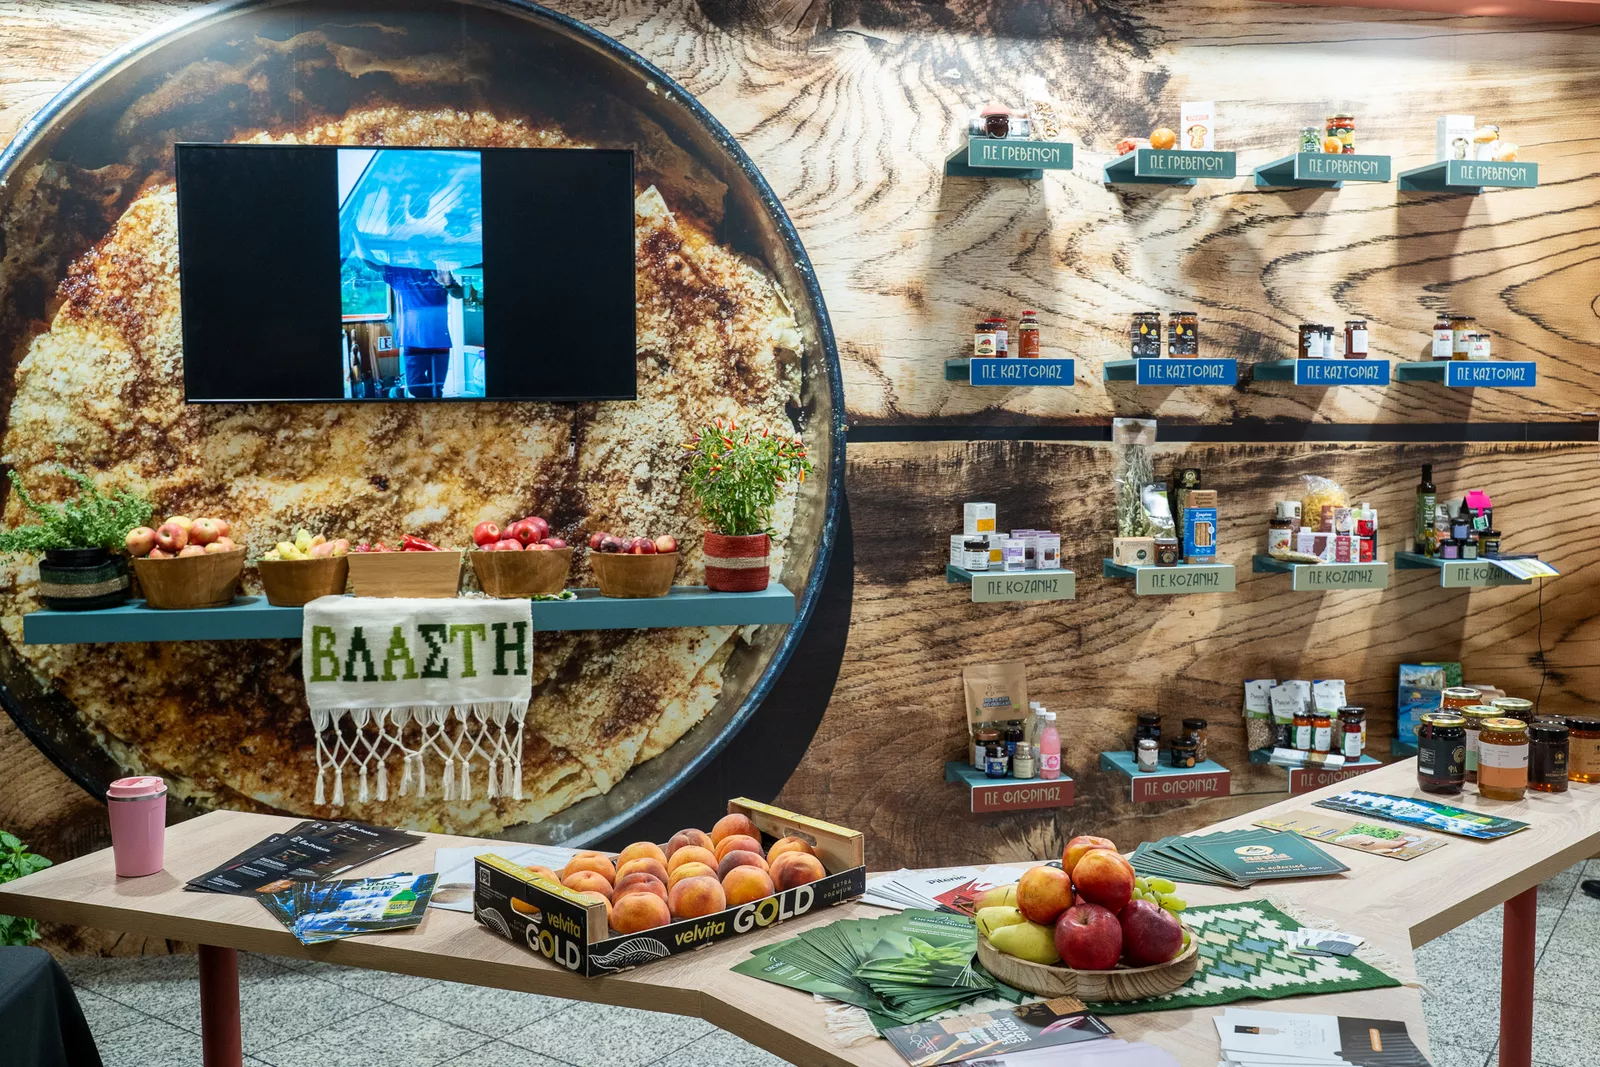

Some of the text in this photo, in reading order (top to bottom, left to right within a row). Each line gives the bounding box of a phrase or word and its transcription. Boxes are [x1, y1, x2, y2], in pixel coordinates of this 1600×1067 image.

[983, 145, 1060, 162] Π.Ε. ΓΡΕΒΕΝΩΝ
[1150, 154, 1223, 171] Π.Ε. ΓΡΕΒΕΝΩΝ
[1309, 158, 1378, 174] Π.Ε. ΓΡΕΒΕΝΩΝ
[1460, 165, 1526, 181] Π.Ε. ΓΡΕΒΕΝΩΝ
[982, 364, 1062, 379] Π.Ε. ΚΑΣΤΟΡΙΑΣ
[1148, 364, 1225, 379] Π.Ε. ΚΑΣΤΟΡΙΑΣ
[1307, 365, 1379, 380] Π.Ε. ΚΑΣΤΟΡΙΑΣ
[1457, 367, 1526, 381] Π.Ε. ΚΑΣΤΟΡΙΑΣ
[1152, 572, 1220, 588] Π.Ε. ΚΟΖΑΝΗΣ
[1309, 569, 1373, 585] Π.Ε. ΚΟΖΑΝΗΣ
[1458, 568, 1472, 581] Π.Ε.
[988, 579, 1059, 596] Π.Ε. ΚΟΖΑΝΗΣ
[310, 621, 528, 683] ΒΛΑΣΤΗ
[1145, 778, 1218, 796] Π.Ε. ΦΛΩΡΙΝΑΣ
[984, 787, 1061, 806] Π.Ε. ΦΛΩΡΙΝΑΣ
[832, 878, 852, 889] EXTRA
[823, 885, 853, 899] PREMIUM
[674, 886, 815, 946] velvita GOLD
[547, 911, 581, 939] velvita
[526, 923, 580, 970] GOLD
